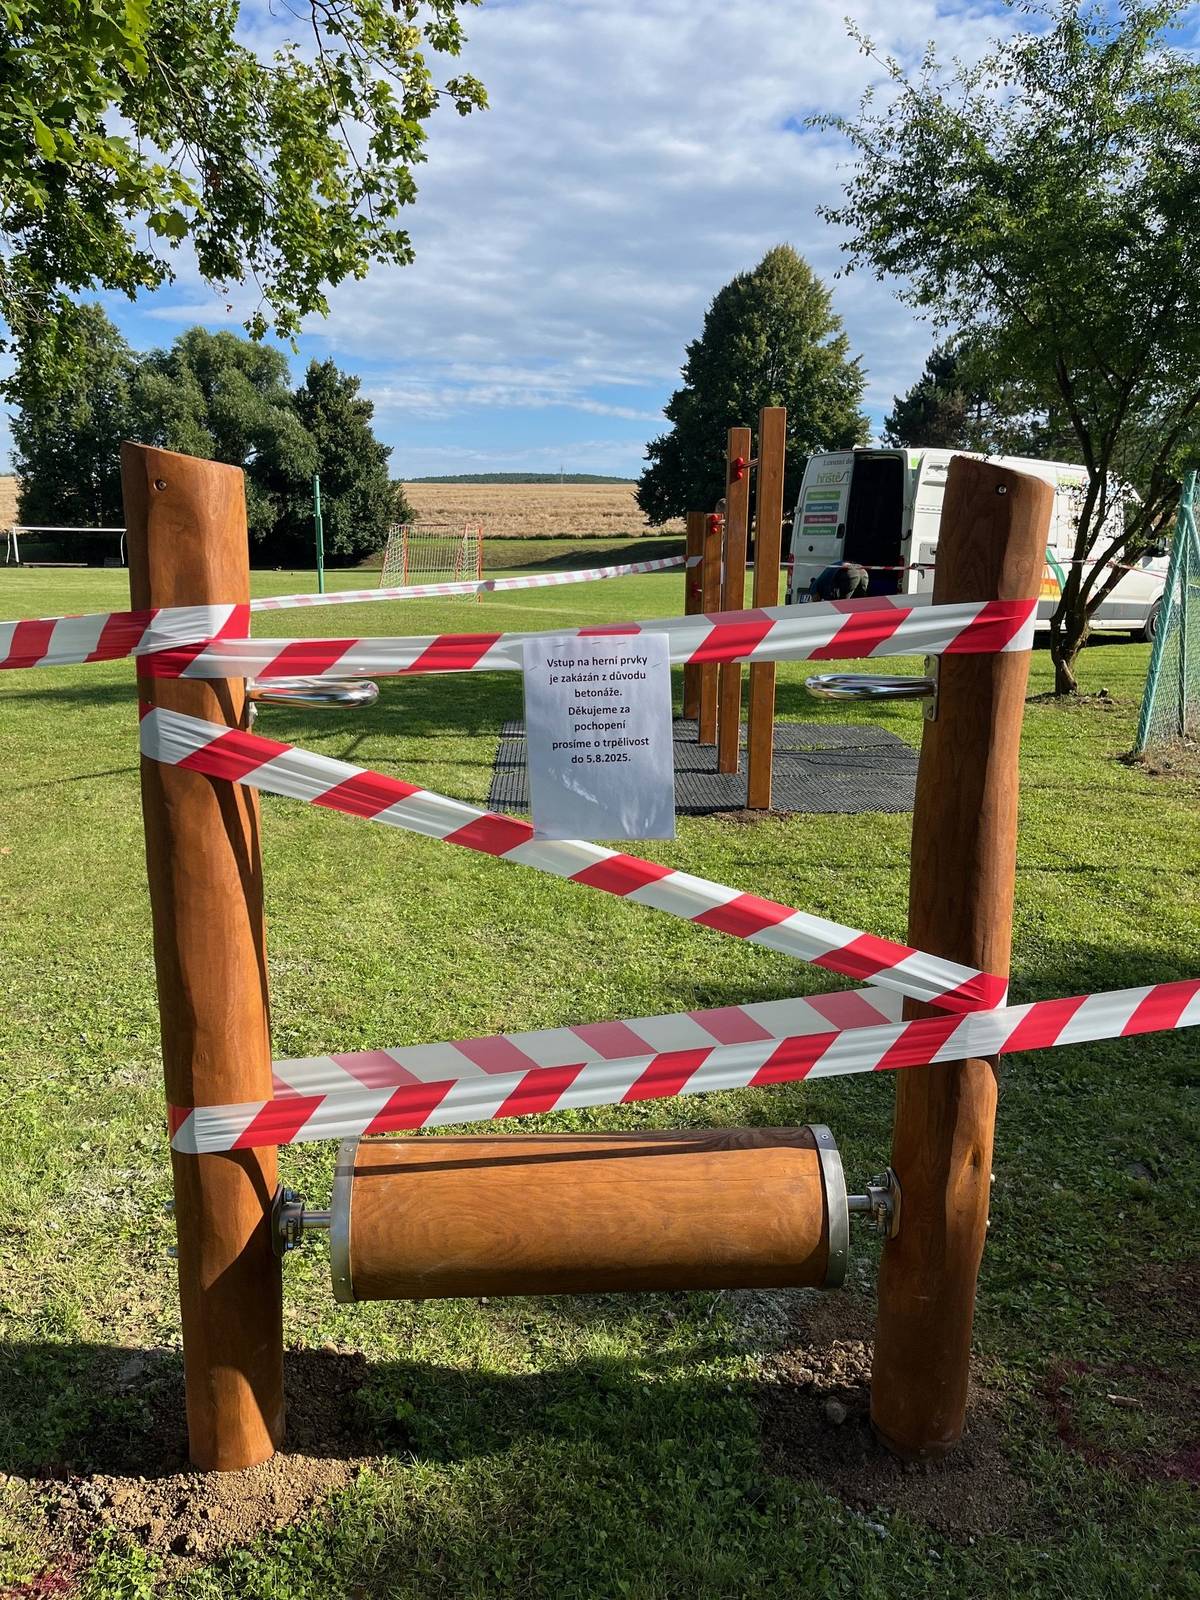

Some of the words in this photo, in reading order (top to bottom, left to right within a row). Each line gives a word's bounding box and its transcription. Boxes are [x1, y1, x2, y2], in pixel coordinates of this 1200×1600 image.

[547, 658, 575, 669] Vstup
[592, 656, 618, 666] herní
[620, 655, 648, 667] prvky
[549, 674, 559, 685] je
[561, 673, 599, 683] zakázán
[609, 671, 646, 681] důvodu
[574, 687, 623, 698] betonáže.
[568, 706, 618, 717] Děkujeme
[620, 706, 631, 714] za
[574, 720, 626, 732] pochopení
[552, 739, 591, 751] prosíme
[594, 740, 601, 748] o
[603, 737, 650, 749] trpělivost
[571, 755, 584, 764] do
[586, 753, 632, 764] 5.8.2025.
